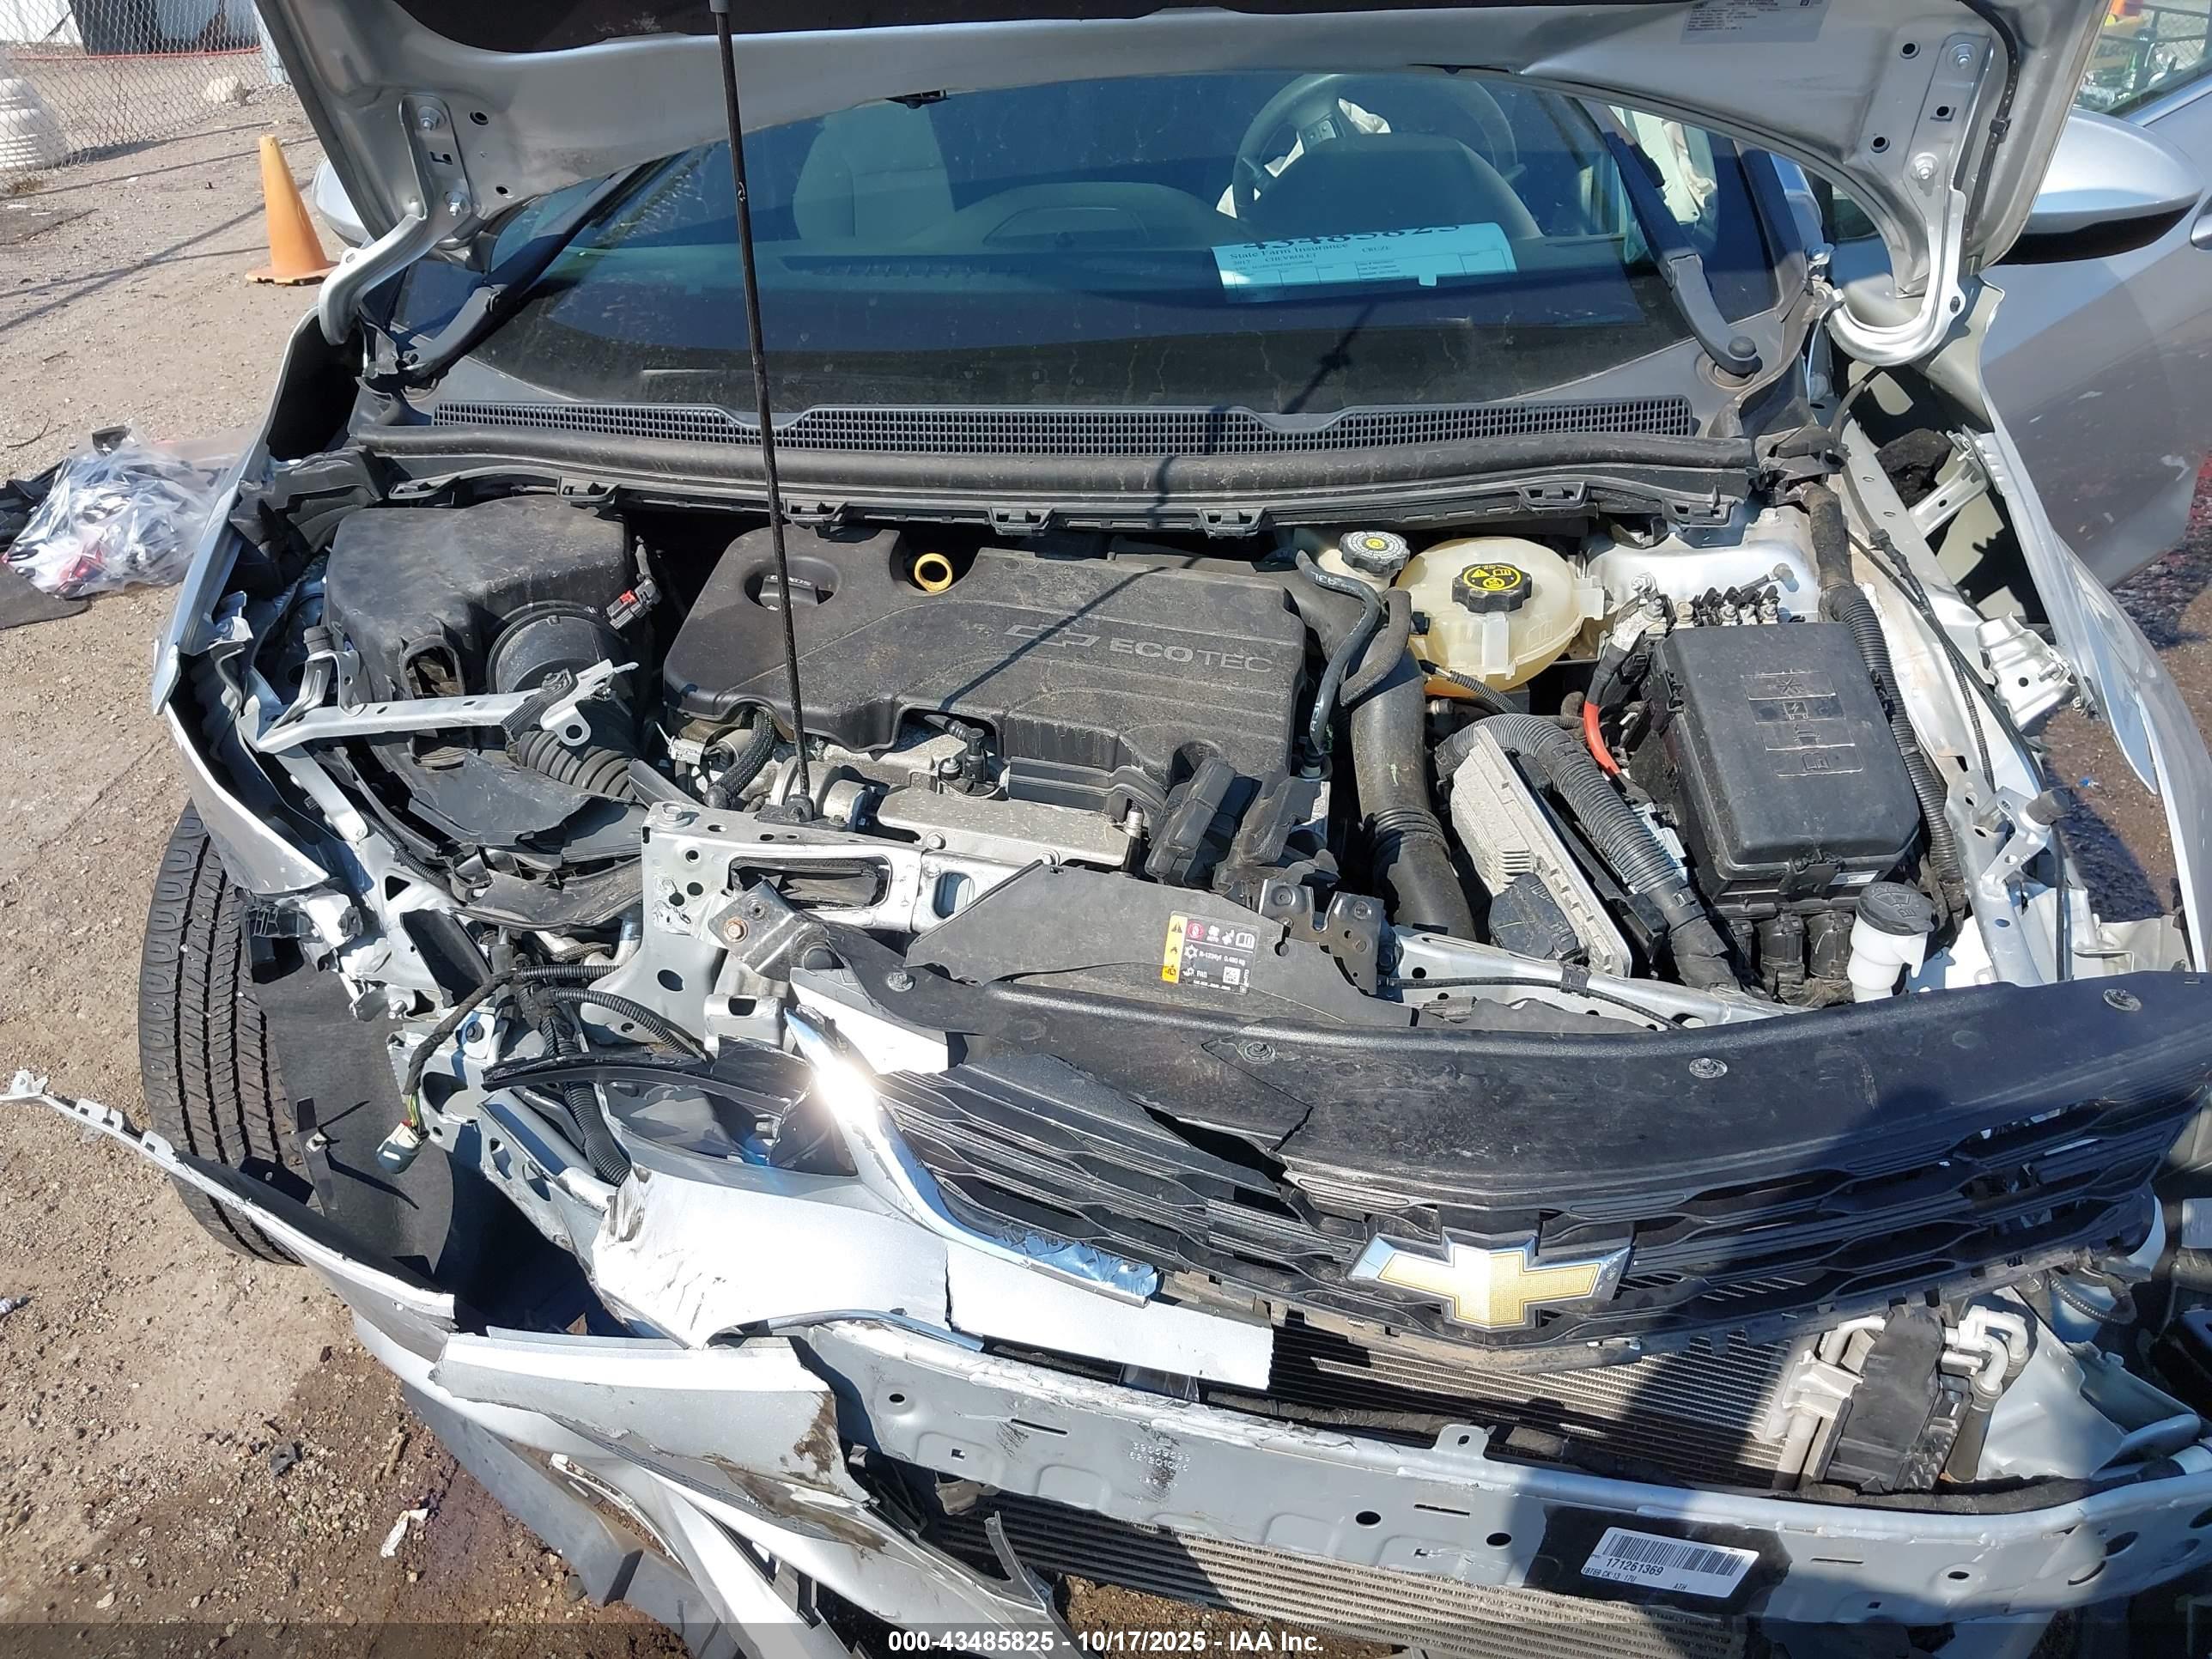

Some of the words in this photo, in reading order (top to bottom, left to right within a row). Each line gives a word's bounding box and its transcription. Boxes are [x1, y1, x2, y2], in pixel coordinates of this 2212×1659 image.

[1295, 243, 1349, 252] Insurance
[1109, 636, 1273, 673] ECOTEC
[1606, 1557, 1664, 1576] 171261369
